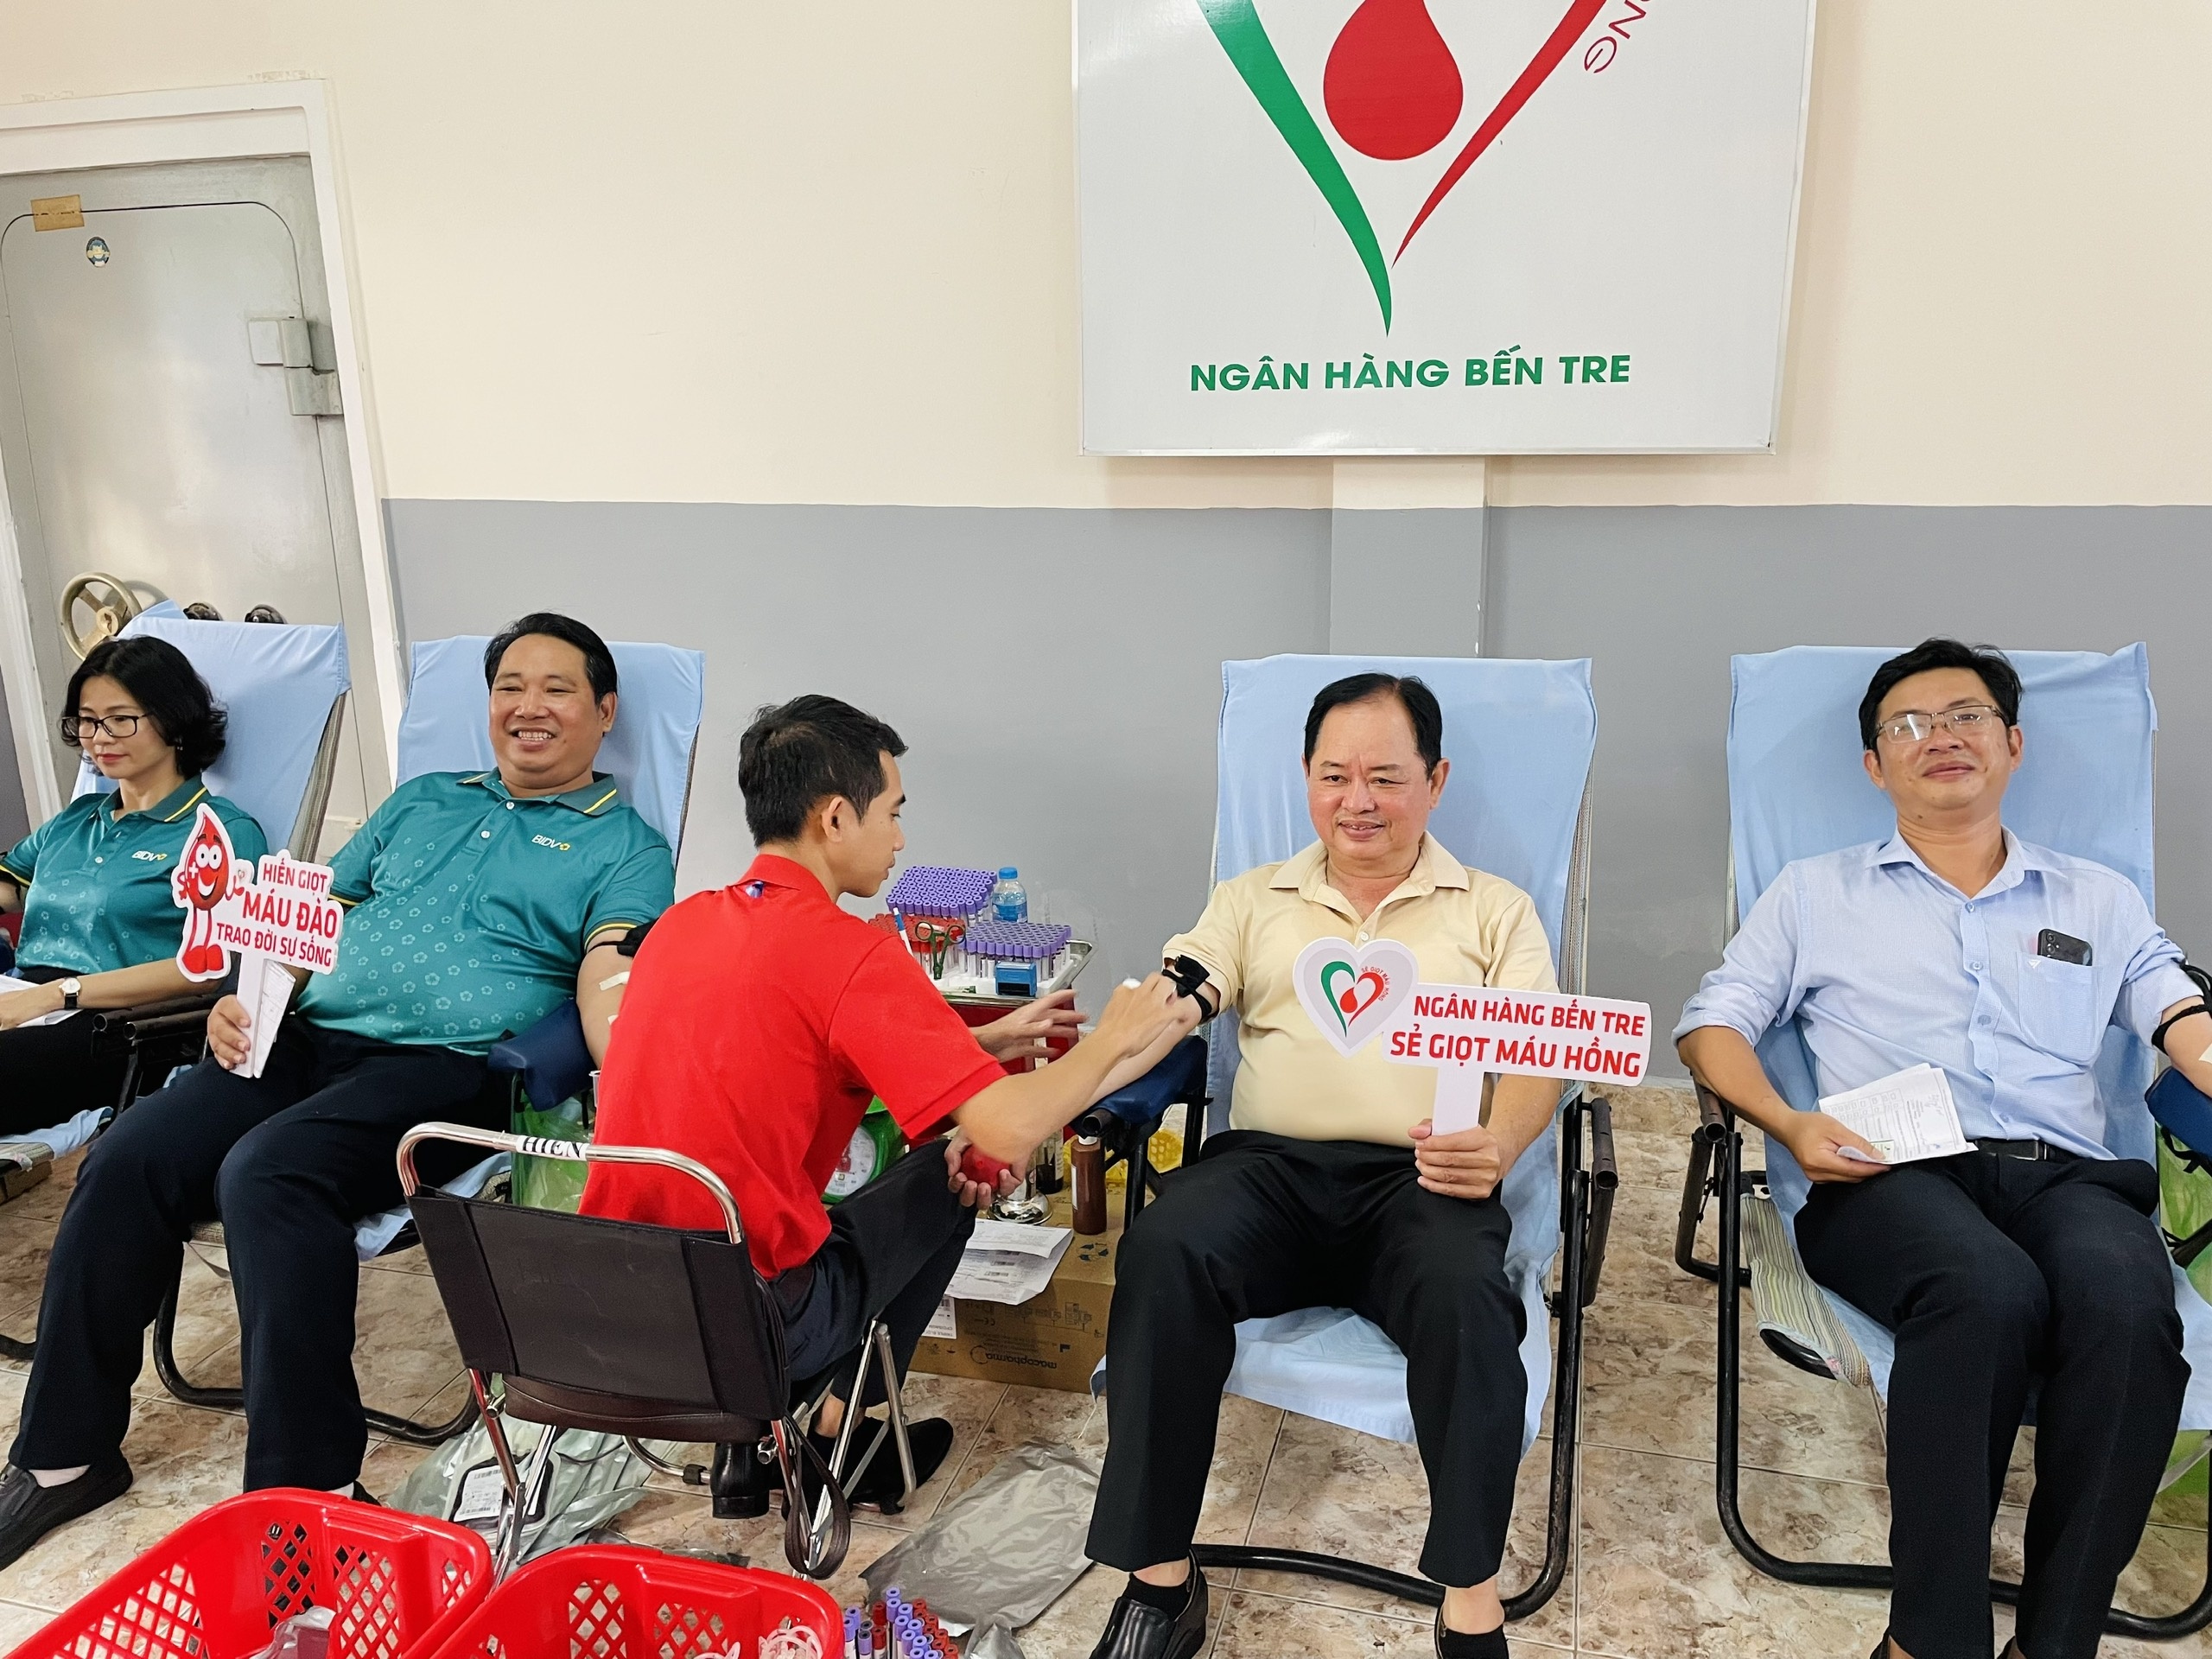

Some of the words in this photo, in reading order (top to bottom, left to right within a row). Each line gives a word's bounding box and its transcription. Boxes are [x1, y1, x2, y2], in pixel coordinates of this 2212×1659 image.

[1584, 0, 1651, 74] NG
[1190, 355, 1309, 392] NGÂN
[1325, 352, 1450, 389] HÀNG
[1465, 345, 1543, 386] BẾN
[1559, 354, 1630, 385] TRE
[531, 834, 562, 849] BIDV
[263, 857, 295, 887] HIẾN
[298, 869, 327, 896] GIỌT
[243, 888, 292, 927] MÁU
[296, 897, 338, 939] ĐÀO
[216, 922, 251, 947] TRAO
[254, 929, 277, 953] ĐỜI
[279, 936, 298, 962] SỰ
[298, 935, 332, 967] SỐNG
[1414, 993, 1478, 1020] NGÂN
[1482, 996, 1545, 1027] HÀNG
[1550, 998, 1597, 1032] BẾN
[1602, 1011, 1646, 1037] TRE
[1390, 1023, 1422, 1057] SẺ
[1428, 1033, 1491, 1067] GIỌT
[1495, 1035, 1558, 1068] MÁU
[1563, 1036, 1642, 1078] HỒNG
[985, 1353, 1058, 1370] macopharma
